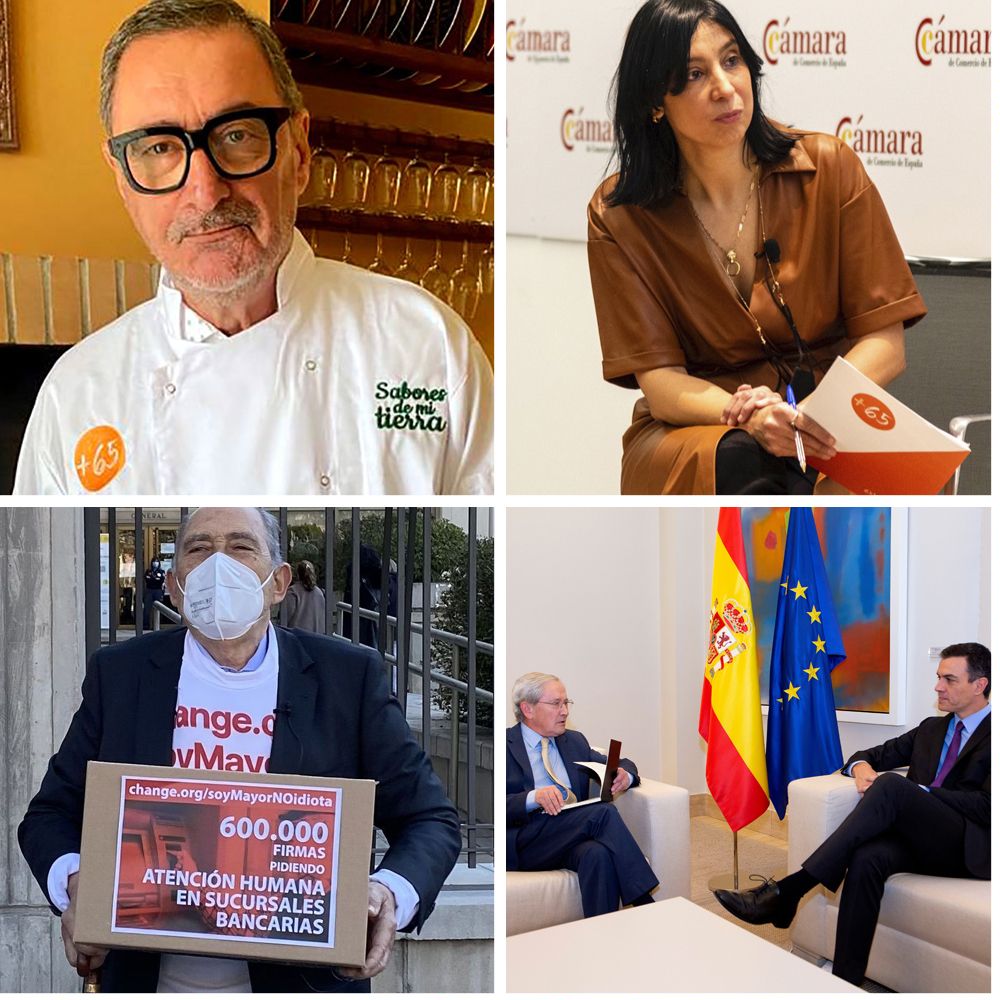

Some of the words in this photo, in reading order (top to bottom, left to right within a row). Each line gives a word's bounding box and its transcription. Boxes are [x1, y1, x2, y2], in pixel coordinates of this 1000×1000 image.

[561, 107, 616, 150] Cáma
[375, 381, 447, 401] Sabores
[374, 406, 447, 432] tierra
[393, 399, 414, 414] de
[415, 401, 436, 416] mi
[77, 440, 119, 477] +65
[129, 783, 333, 807] change.org/soyMayorNOidiota
[219, 816, 329, 844] 600.000
[273, 844, 326, 859] FIRMAS
[269, 861, 325, 875] PIDIENDO
[142, 868, 235, 890] ATENCIÓN
[240, 875, 326, 897] HUMANA
[176, 890, 200, 906] EN
[204, 892, 325, 915] SUCURSALES
[216, 911, 324, 935] BANCARIAS
